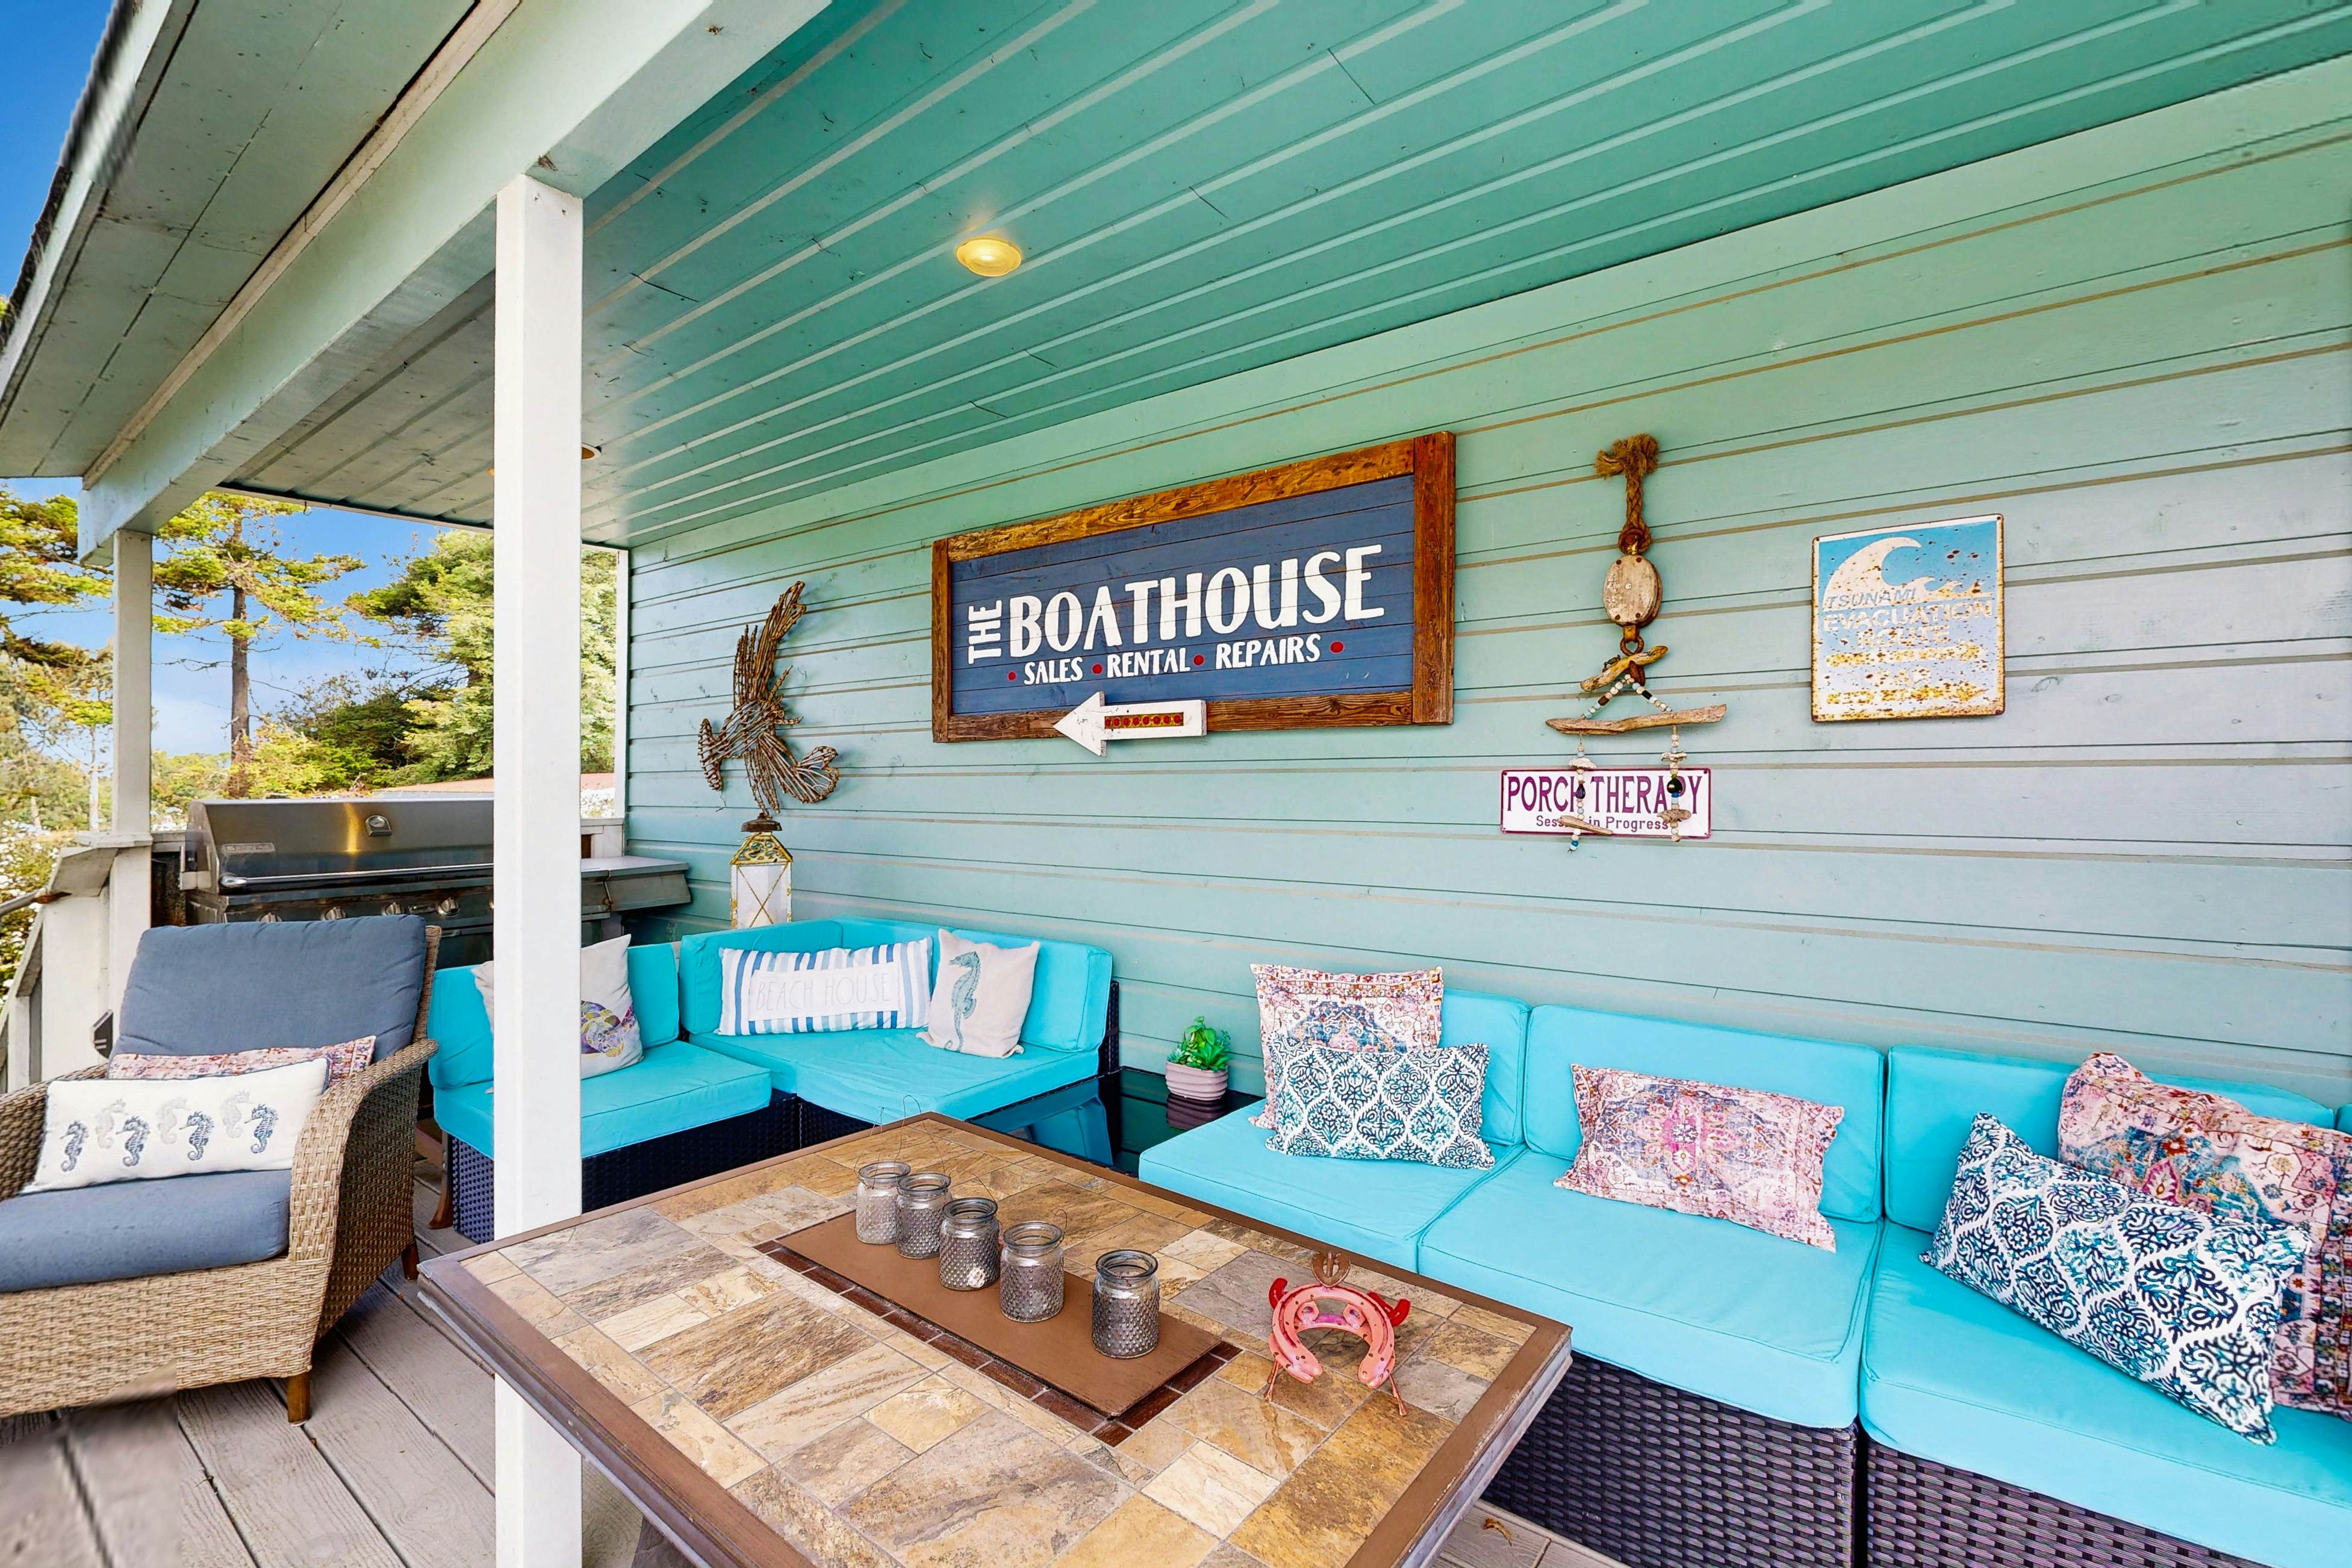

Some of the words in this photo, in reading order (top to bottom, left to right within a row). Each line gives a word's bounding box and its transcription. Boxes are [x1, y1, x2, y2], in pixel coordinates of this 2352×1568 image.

[1010, 544, 1385, 658] BOATHOUSE
[1823, 600, 1993, 631] EVACUATION
[1827, 588, 1917, 608] TSUNAMI
[968, 600, 1002, 664] THE
[1856, 625, 1950, 648] ROUTE
[1024, 657, 1083, 685] SALES
[1107, 647, 1190, 678] RENTAL
[1216, 634, 1321, 670] REPAIRS
[1605, 817, 1669, 832] Progress
[757, 978, 814, 1011] BEACH
[824, 972, 891, 1007] HOUSE
